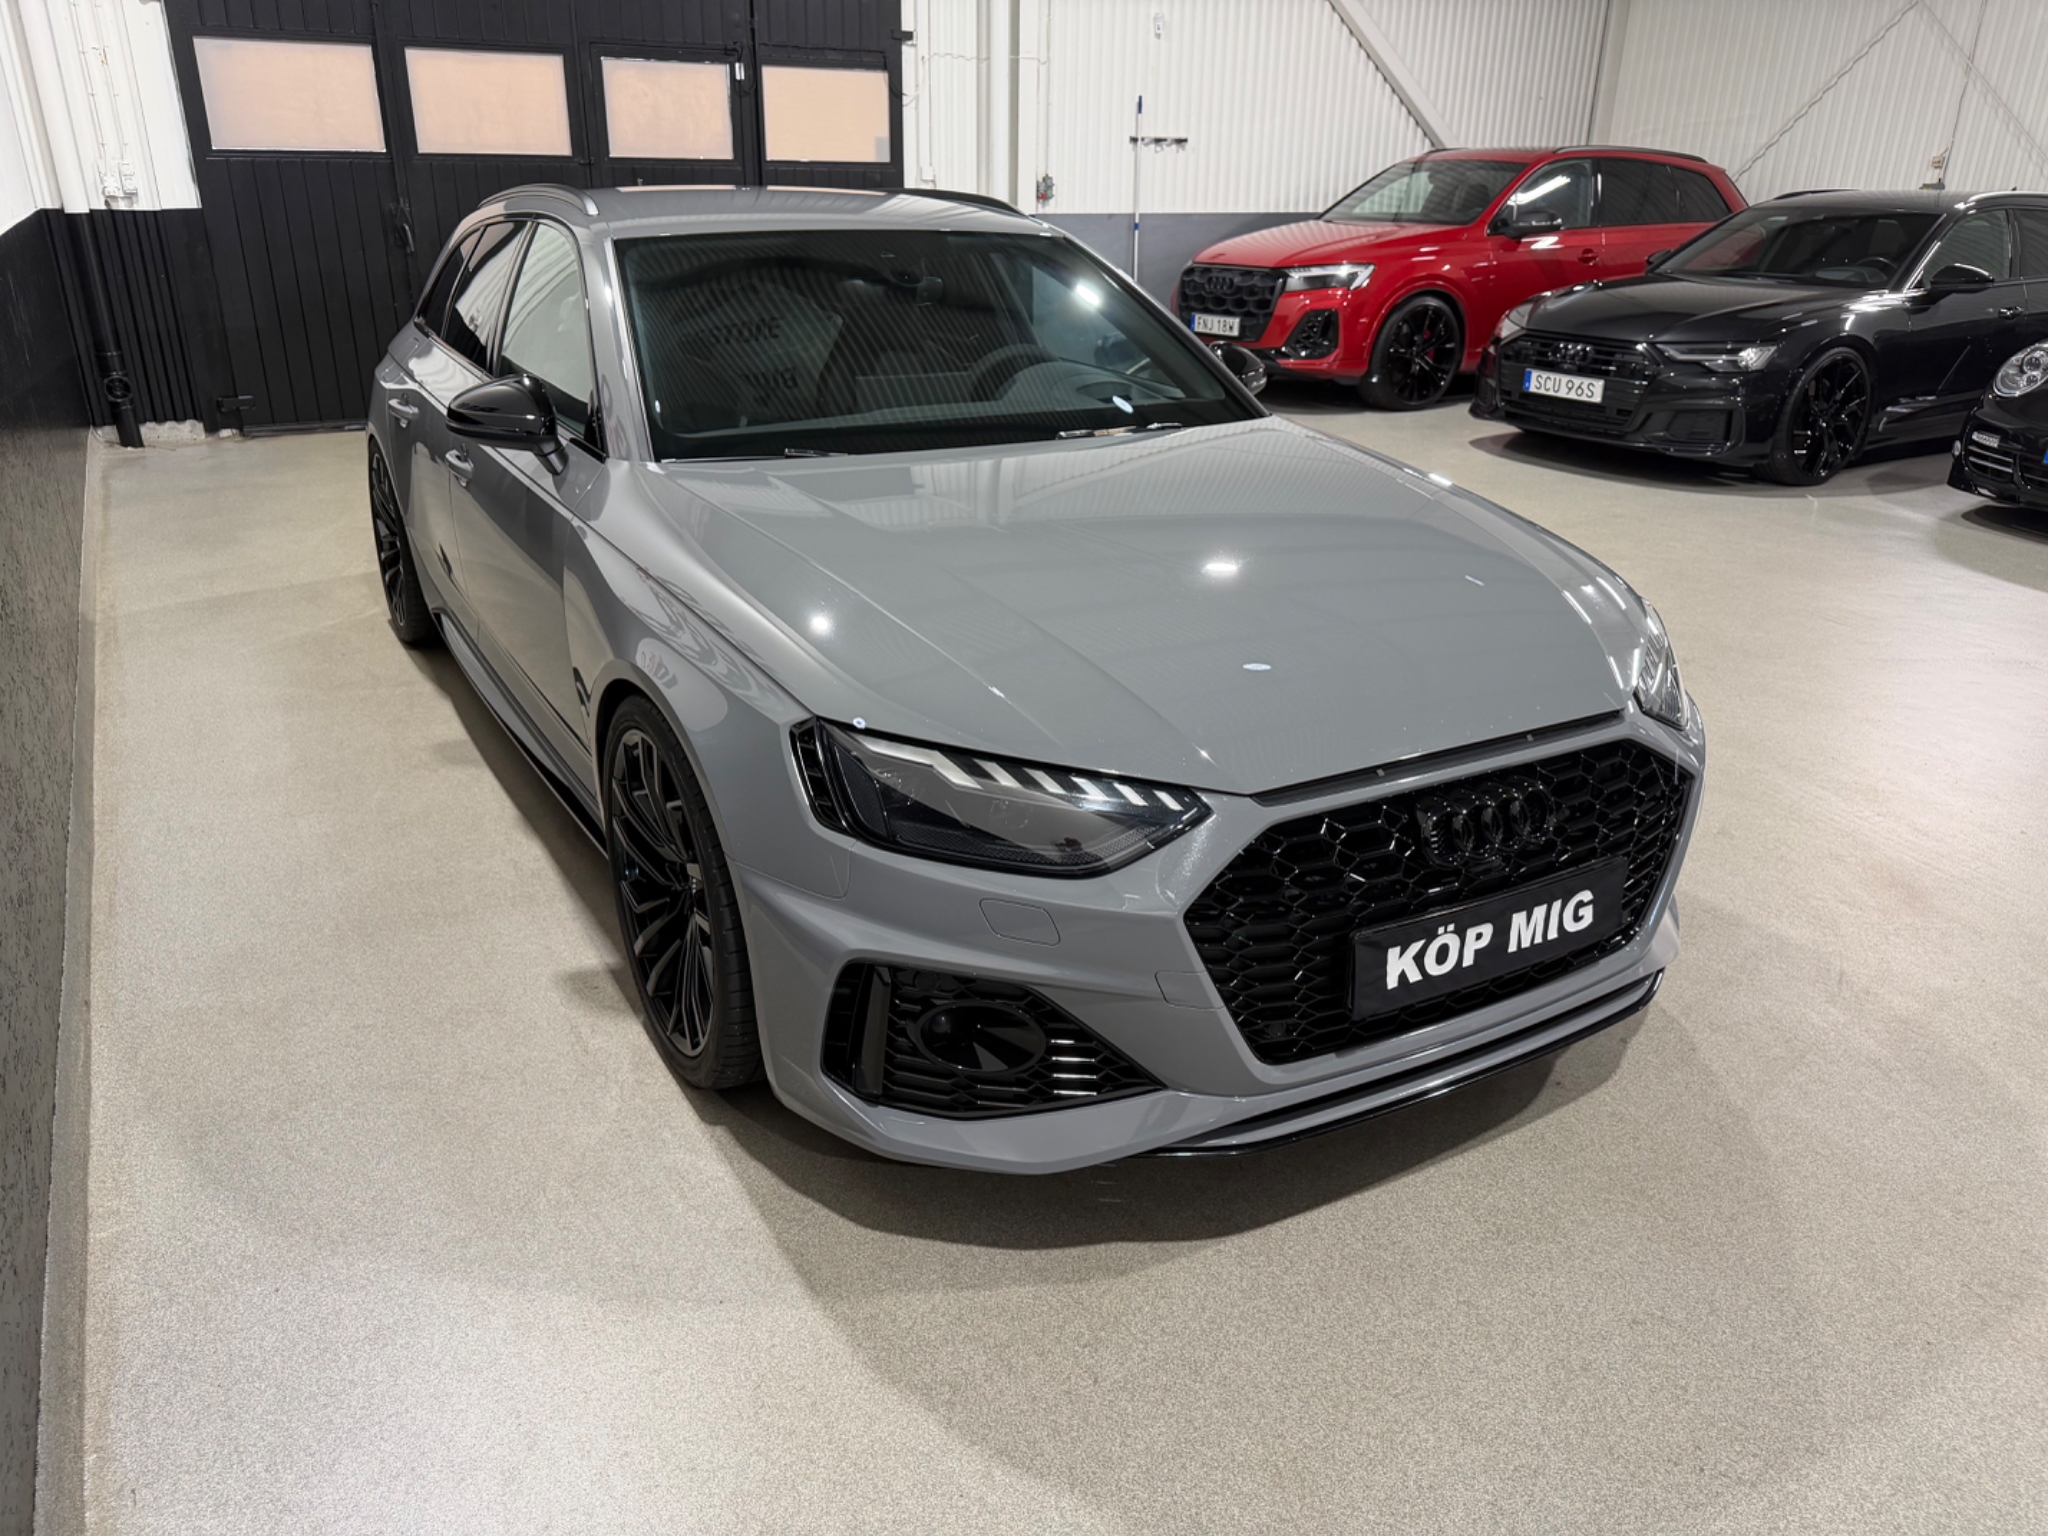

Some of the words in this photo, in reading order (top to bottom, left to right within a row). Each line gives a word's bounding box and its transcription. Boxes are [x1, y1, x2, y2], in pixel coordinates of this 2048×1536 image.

[1197, 316, 1214, 331] FNJ
[1534, 374, 1562, 393] SCU
[1565, 379, 1595, 398] 96S
[1386, 923, 1494, 990] KÖP
[1507, 889, 1594, 953] MIG
